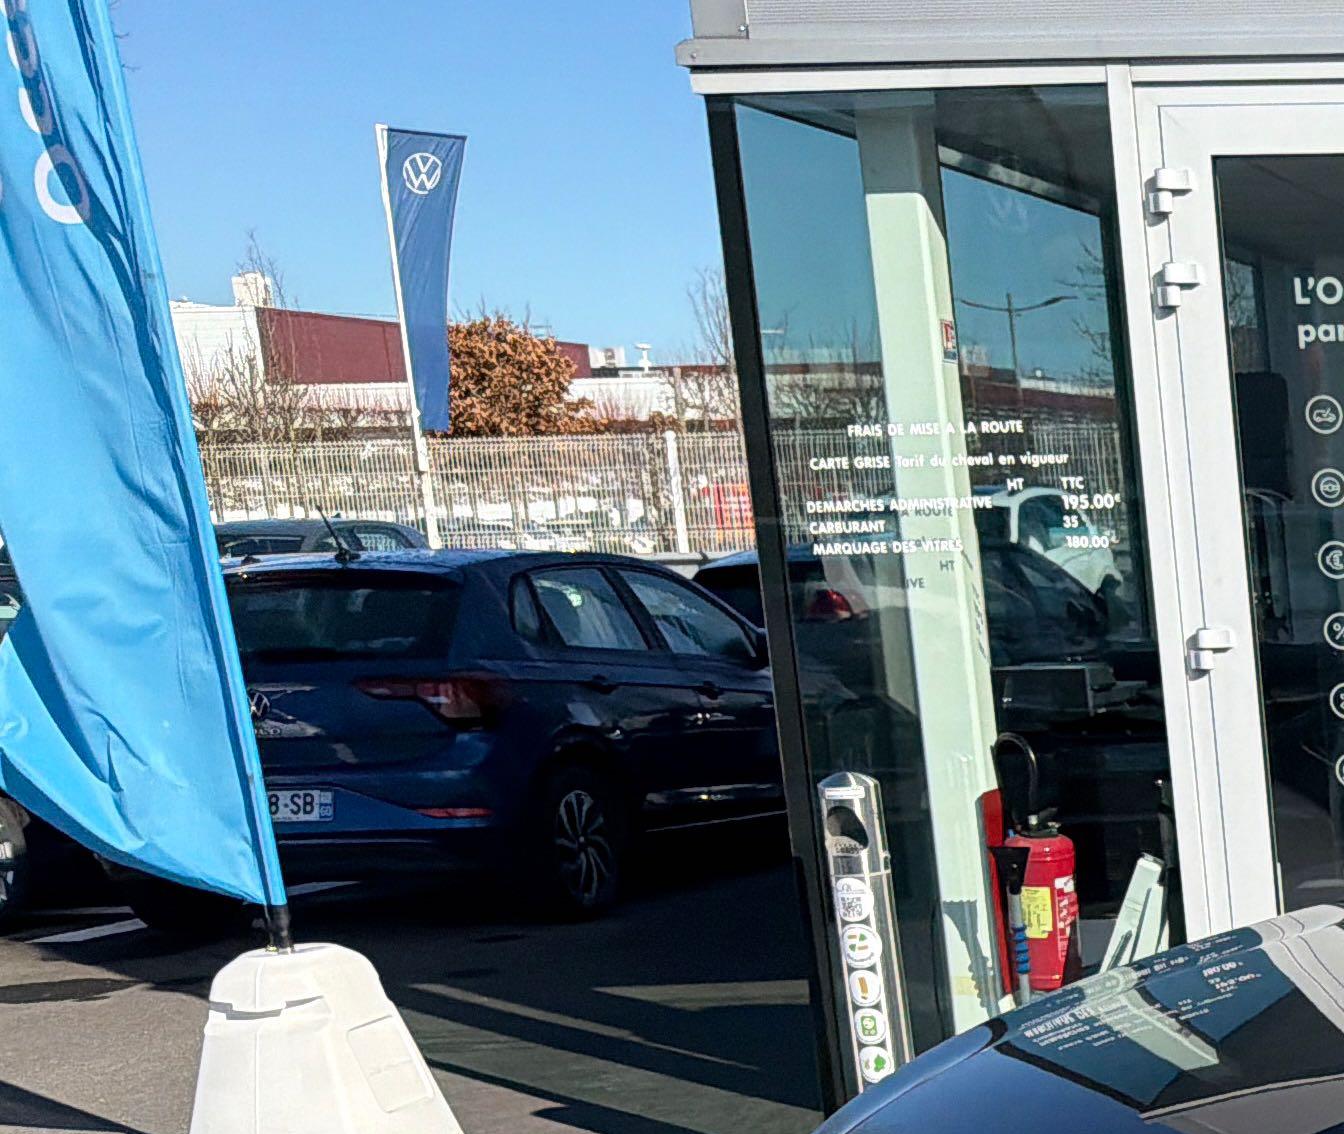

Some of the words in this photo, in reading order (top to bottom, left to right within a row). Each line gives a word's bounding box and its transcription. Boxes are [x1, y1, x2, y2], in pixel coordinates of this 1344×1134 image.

[847, 424, 882, 437] FRAIS
[888, 423, 904, 436] DE
[910, 422, 939, 436] MISE
[960, 421, 976, 434] LA
[981, 420, 1024, 434] ROUTE
[809, 456, 849, 470] CARTE
[854, 455, 890, 469] GRISE
[998, 454, 1015, 466] en
[1020, 451, 1069, 467] vigueur
[1007, 478, 1024, 491] HT
[1060, 476, 1084, 489] TTC
[806, 500, 885, 514] DEMARCHES
[809, 519, 885, 535] CARBURANT
[1063, 515, 1078, 528] 35
[813, 541, 888, 555] MARQUAGE
[892, 540, 917, 553] DES
